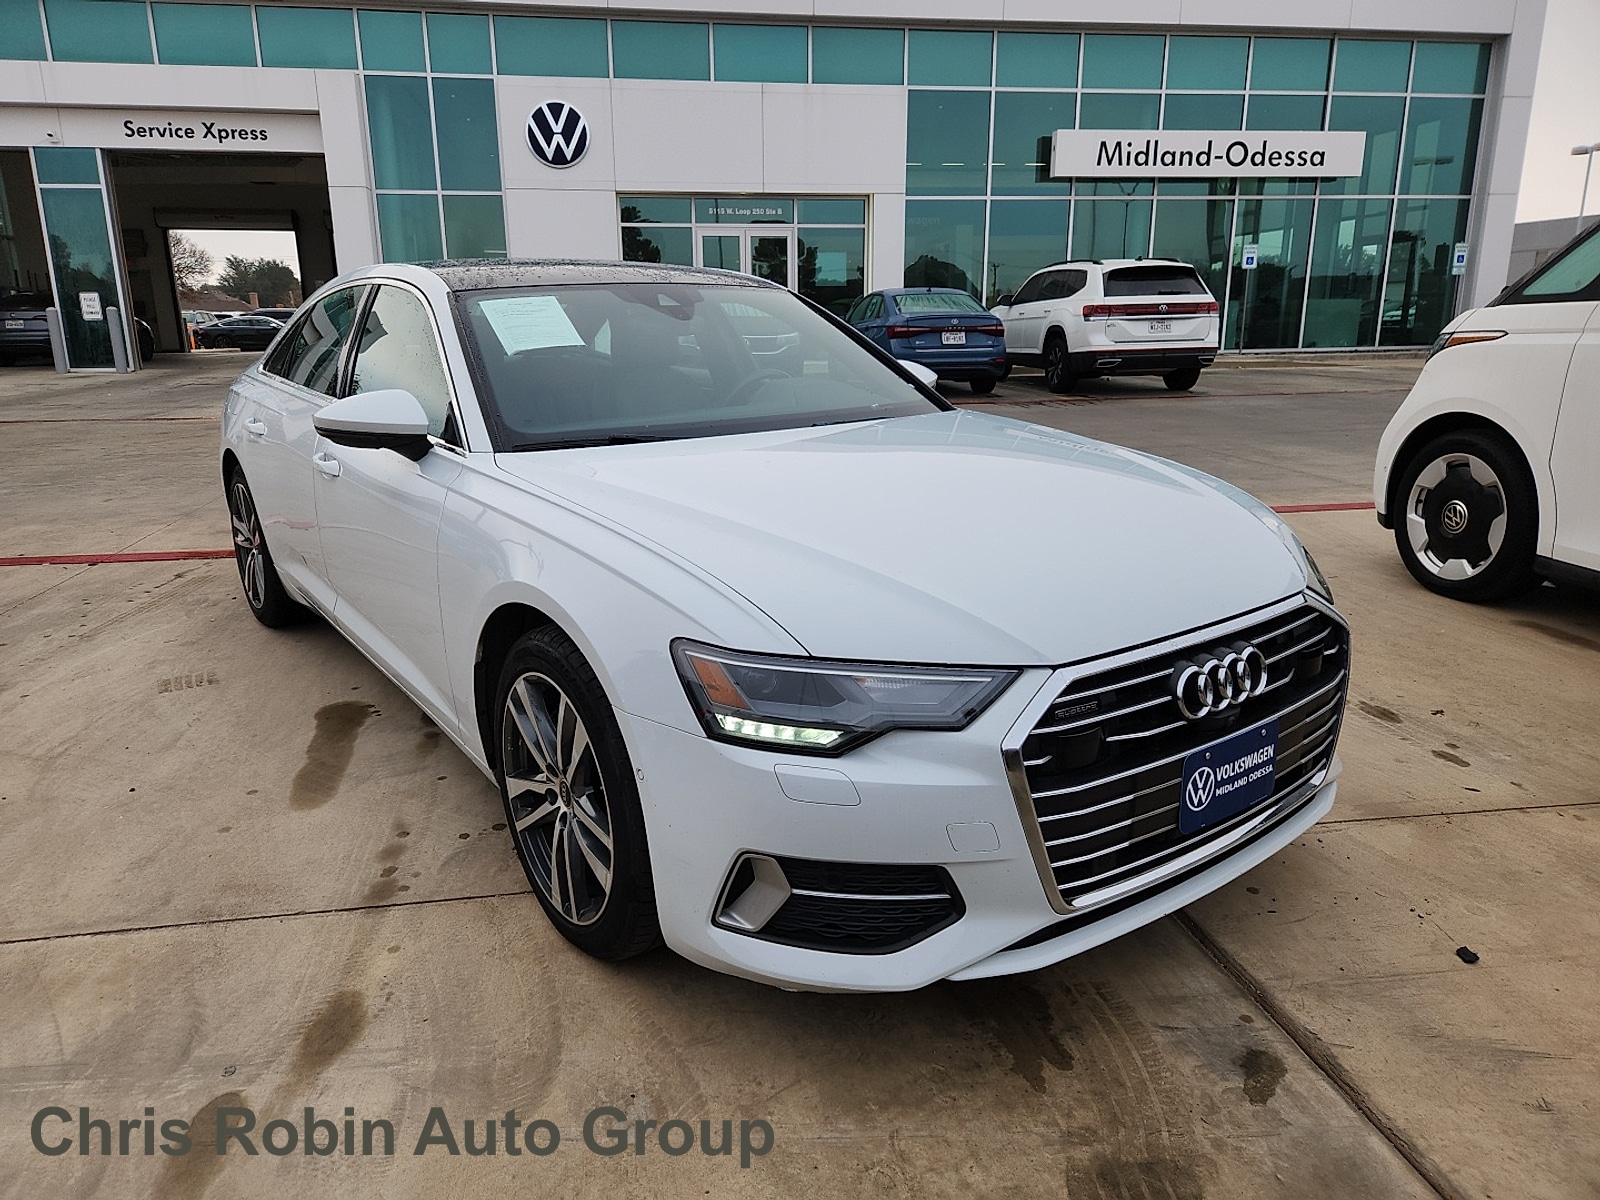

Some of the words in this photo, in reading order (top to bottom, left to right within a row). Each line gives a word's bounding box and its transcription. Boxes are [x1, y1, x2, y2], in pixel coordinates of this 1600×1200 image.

[123, 119, 195, 139] Service
[200, 121, 268, 144] Xpress
[1096, 139, 1326, 168] Midland-Odessa
[708, 207, 726, 215] 5115
[735, 207, 751, 216] Loop
[752, 207, 765, 215] 250
[765, 207, 776, 215] Ste
[1216, 744, 1275, 782] VOLKSWAGEN
[1215, 776, 1248, 797] MIDLAND
[1248, 764, 1274, 782] ODESSA
